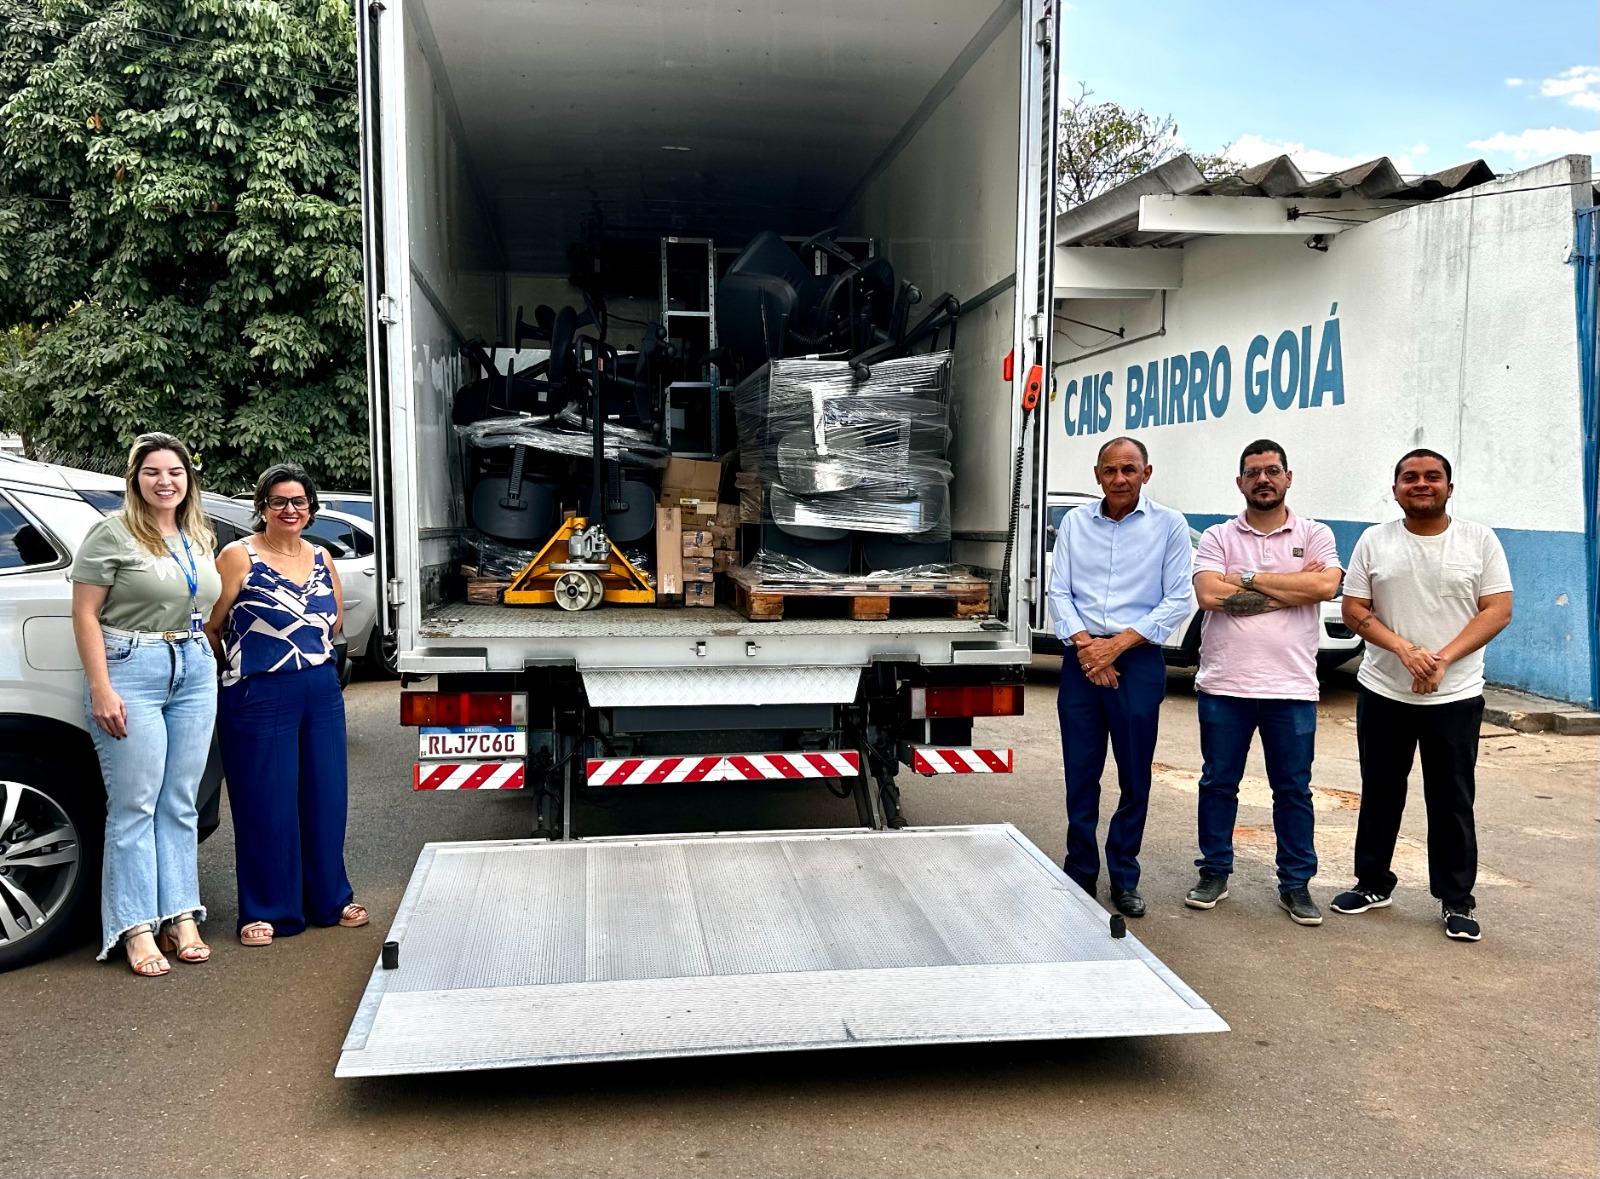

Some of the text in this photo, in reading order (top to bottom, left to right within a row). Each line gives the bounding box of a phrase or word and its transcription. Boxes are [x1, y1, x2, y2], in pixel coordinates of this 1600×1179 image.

[1064, 302, 1345, 436] CAIS BAIRRO GOIÁ
[428, 734, 515, 754] RLJ7C60
